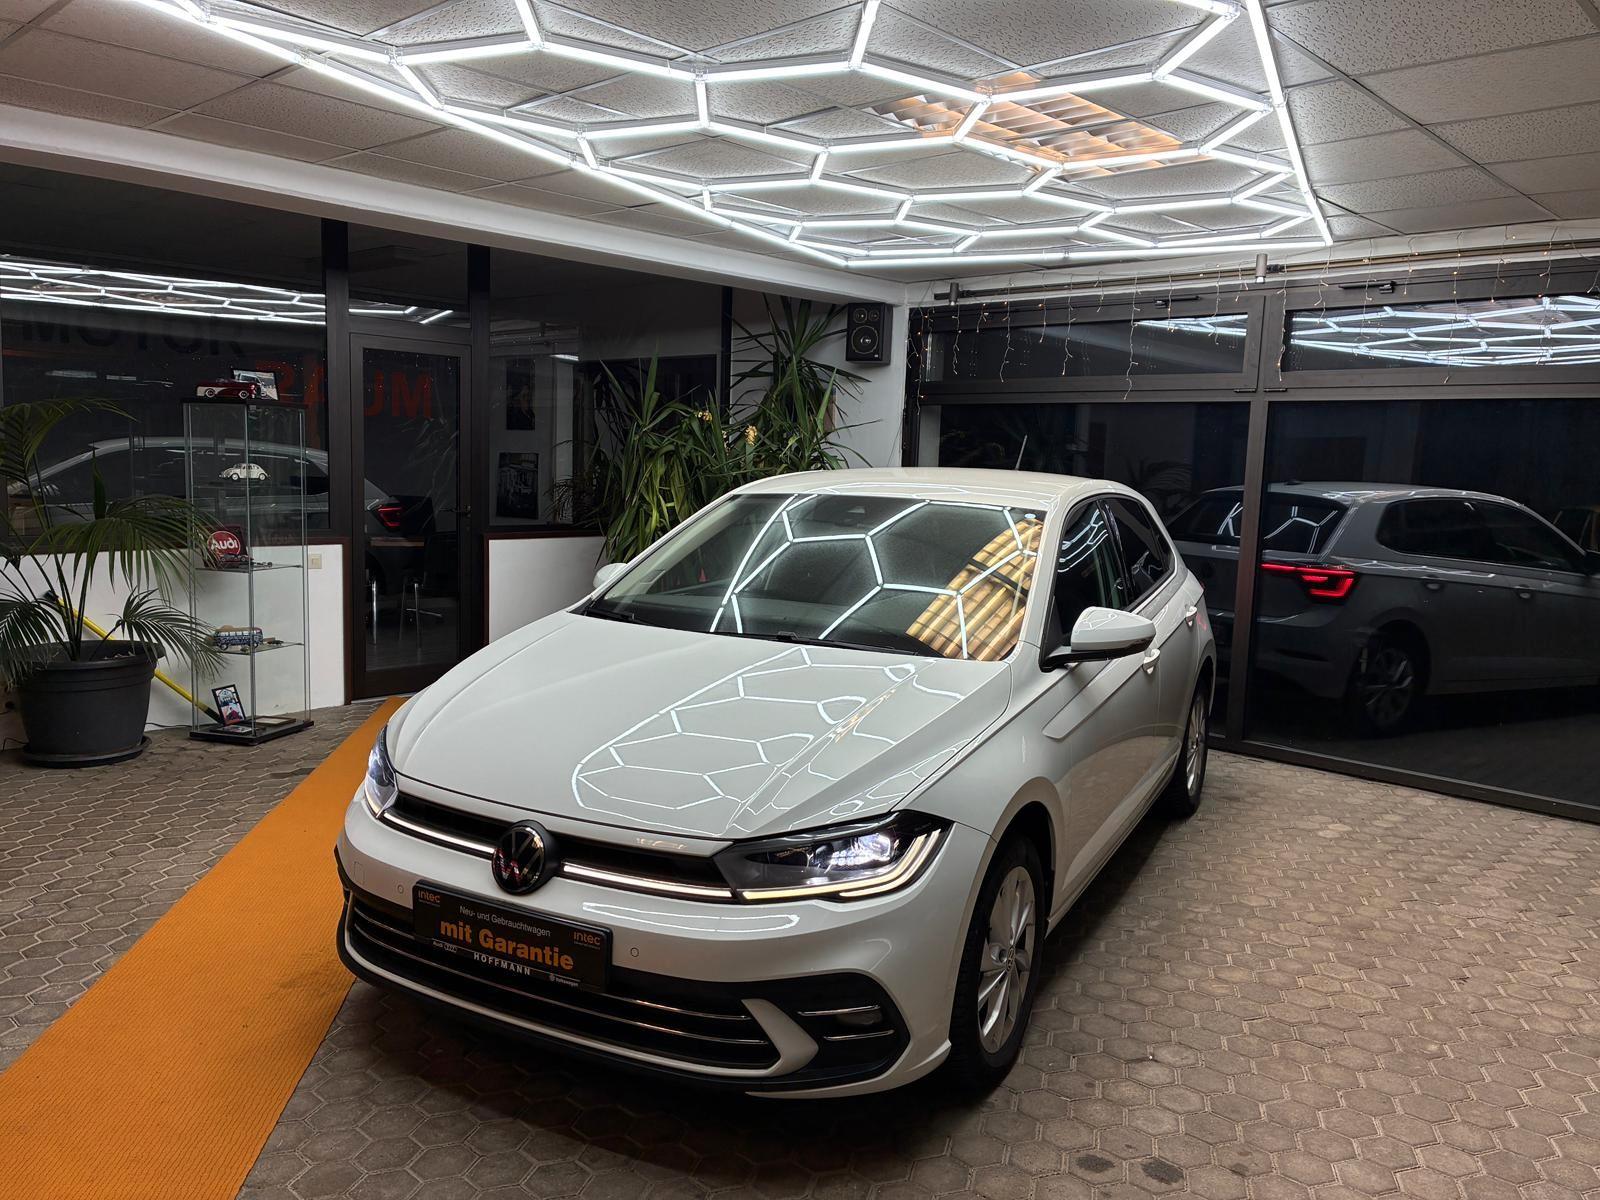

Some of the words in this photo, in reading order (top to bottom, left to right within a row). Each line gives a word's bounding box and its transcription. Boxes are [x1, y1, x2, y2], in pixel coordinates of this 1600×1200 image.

[210, 537, 238, 551] Audi
[460, 905, 476, 917] Neu-
[476, 912, 490, 921] und
[491, 914, 551, 937] Gebrauchtwagen
[440, 920, 472, 943] mit
[479, 929, 575, 970] Garantie
[474, 952, 531, 976] HOFFMANN
